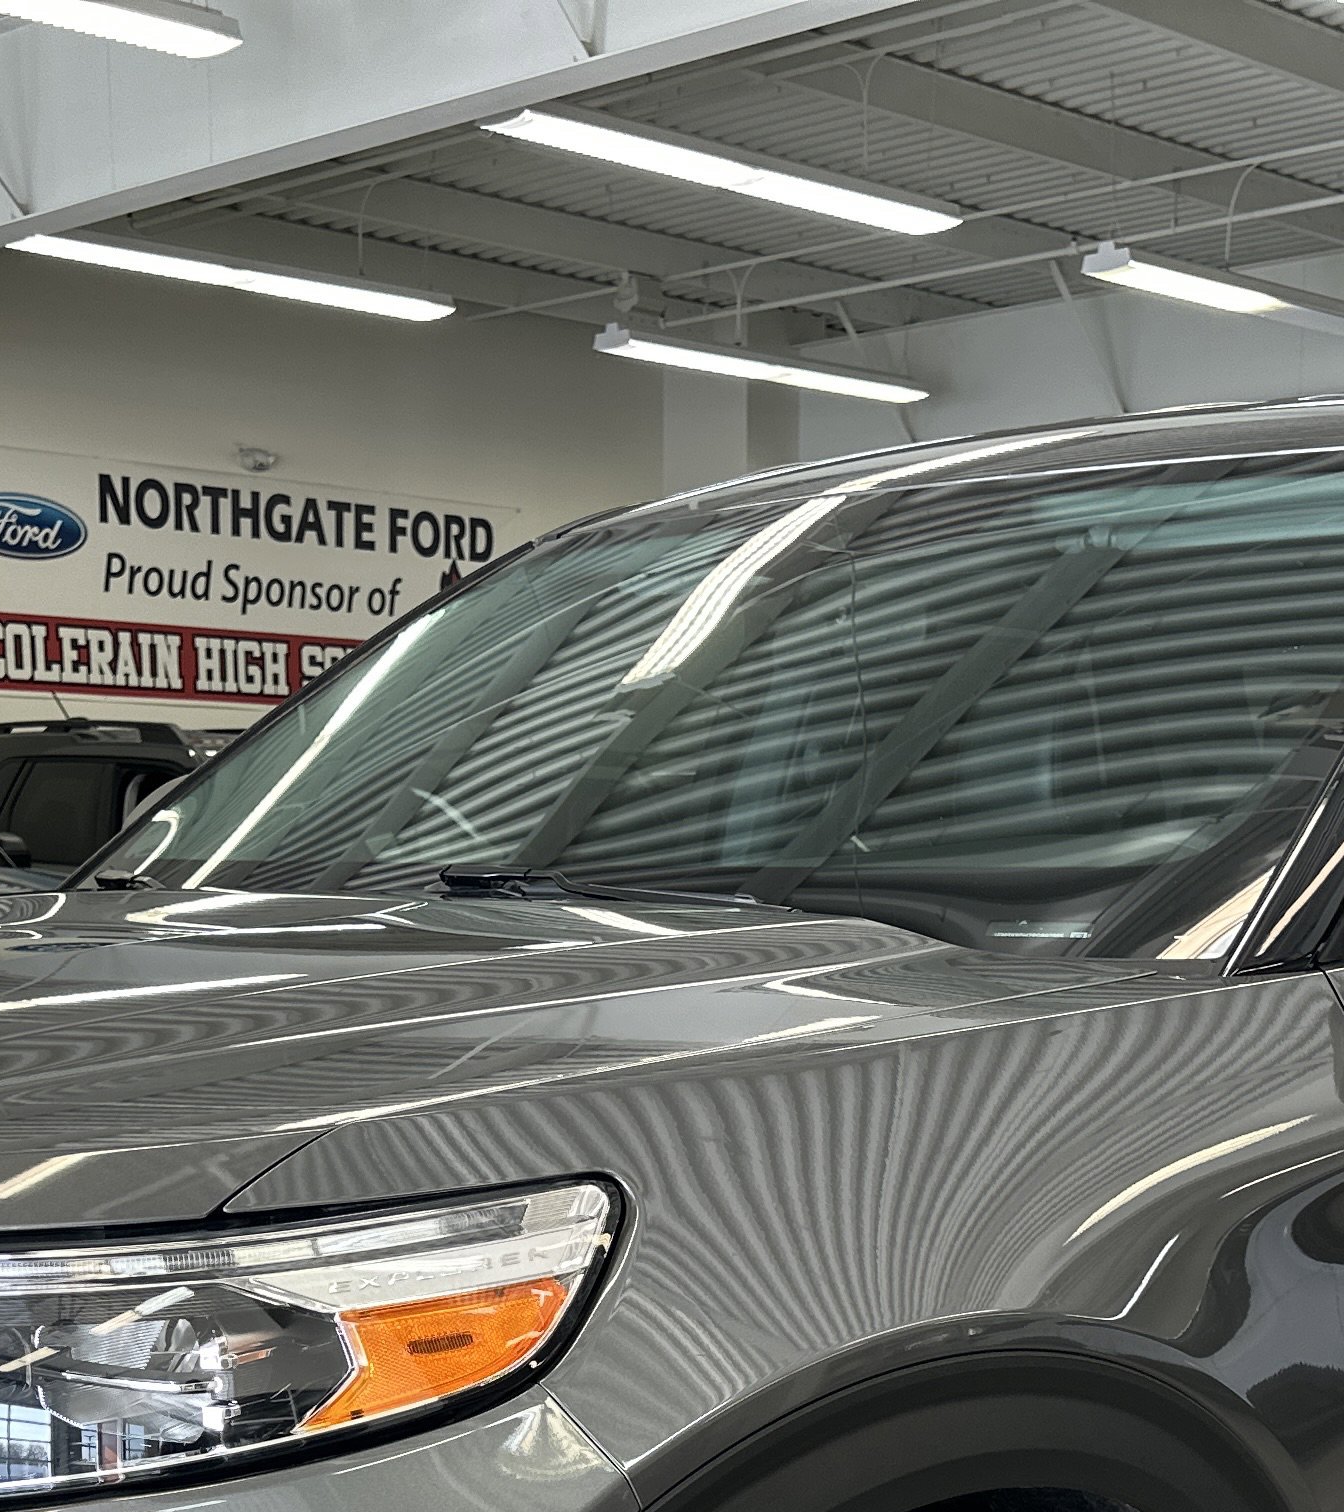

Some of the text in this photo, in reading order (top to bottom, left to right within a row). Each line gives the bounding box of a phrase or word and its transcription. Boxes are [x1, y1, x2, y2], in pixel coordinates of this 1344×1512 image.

[98, 473, 493, 563] NORTHGATE FORD
[103, 552, 402, 617] Proud Sponsor of
[193, 633, 291, 698] HIGH
